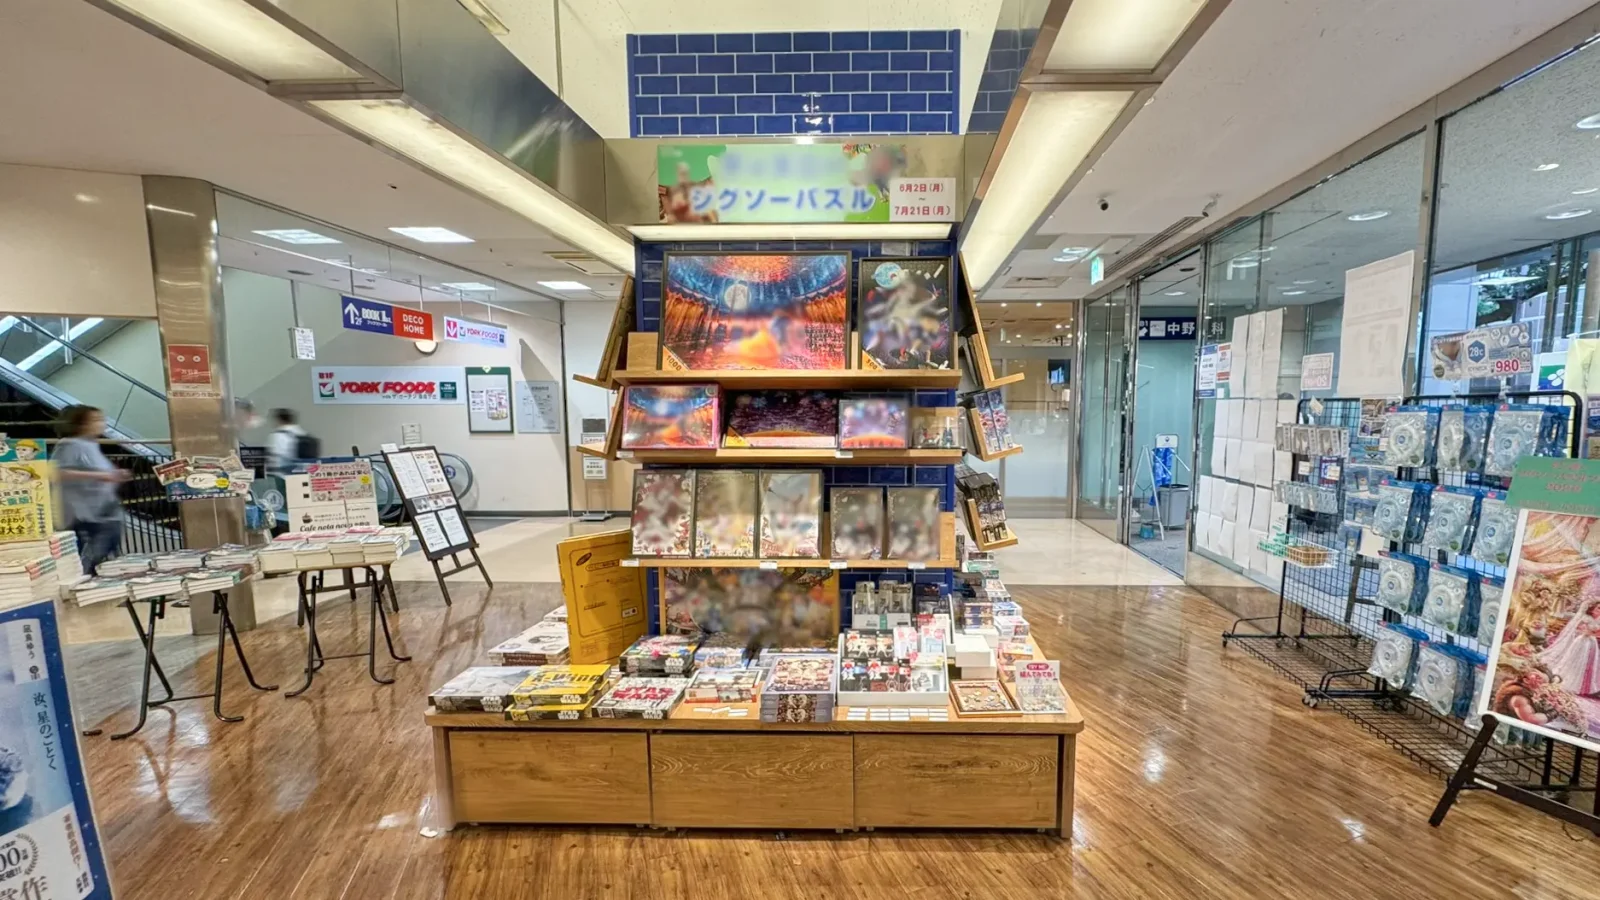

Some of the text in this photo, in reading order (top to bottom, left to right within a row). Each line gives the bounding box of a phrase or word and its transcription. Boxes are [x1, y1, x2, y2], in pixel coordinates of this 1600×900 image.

[894, 205, 951, 216] 7月21日(月)
[402, 313, 425, 325] DECO
[403, 323, 425, 335] HOME
[1167, 321, 1224, 335] 中野 科
[666, 354, 682, 371] 1000
[1495, 359, 1519, 373] 980
[339, 381, 436, 393] YORK FOODS
